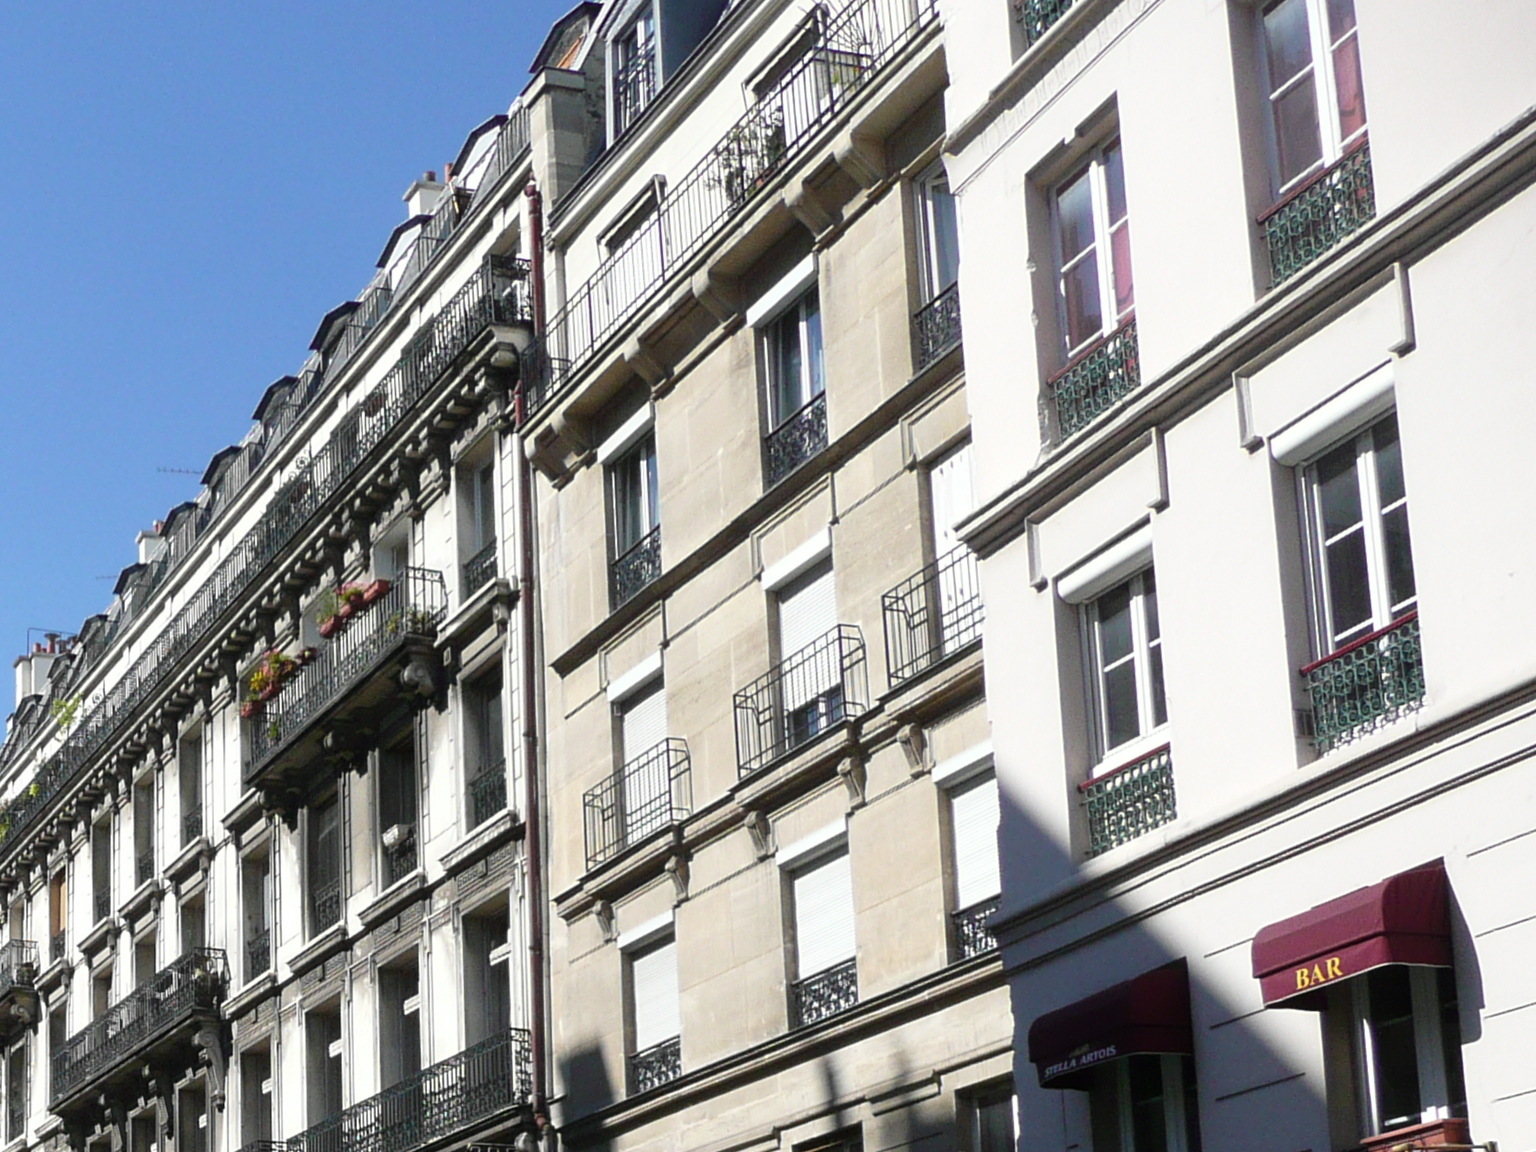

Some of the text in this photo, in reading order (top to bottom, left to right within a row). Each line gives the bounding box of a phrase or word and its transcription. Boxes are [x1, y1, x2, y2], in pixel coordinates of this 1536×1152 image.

[1295, 957, 1344, 990] BAR
[1044, 1044, 1116, 1078] STELLA ARTOIS
